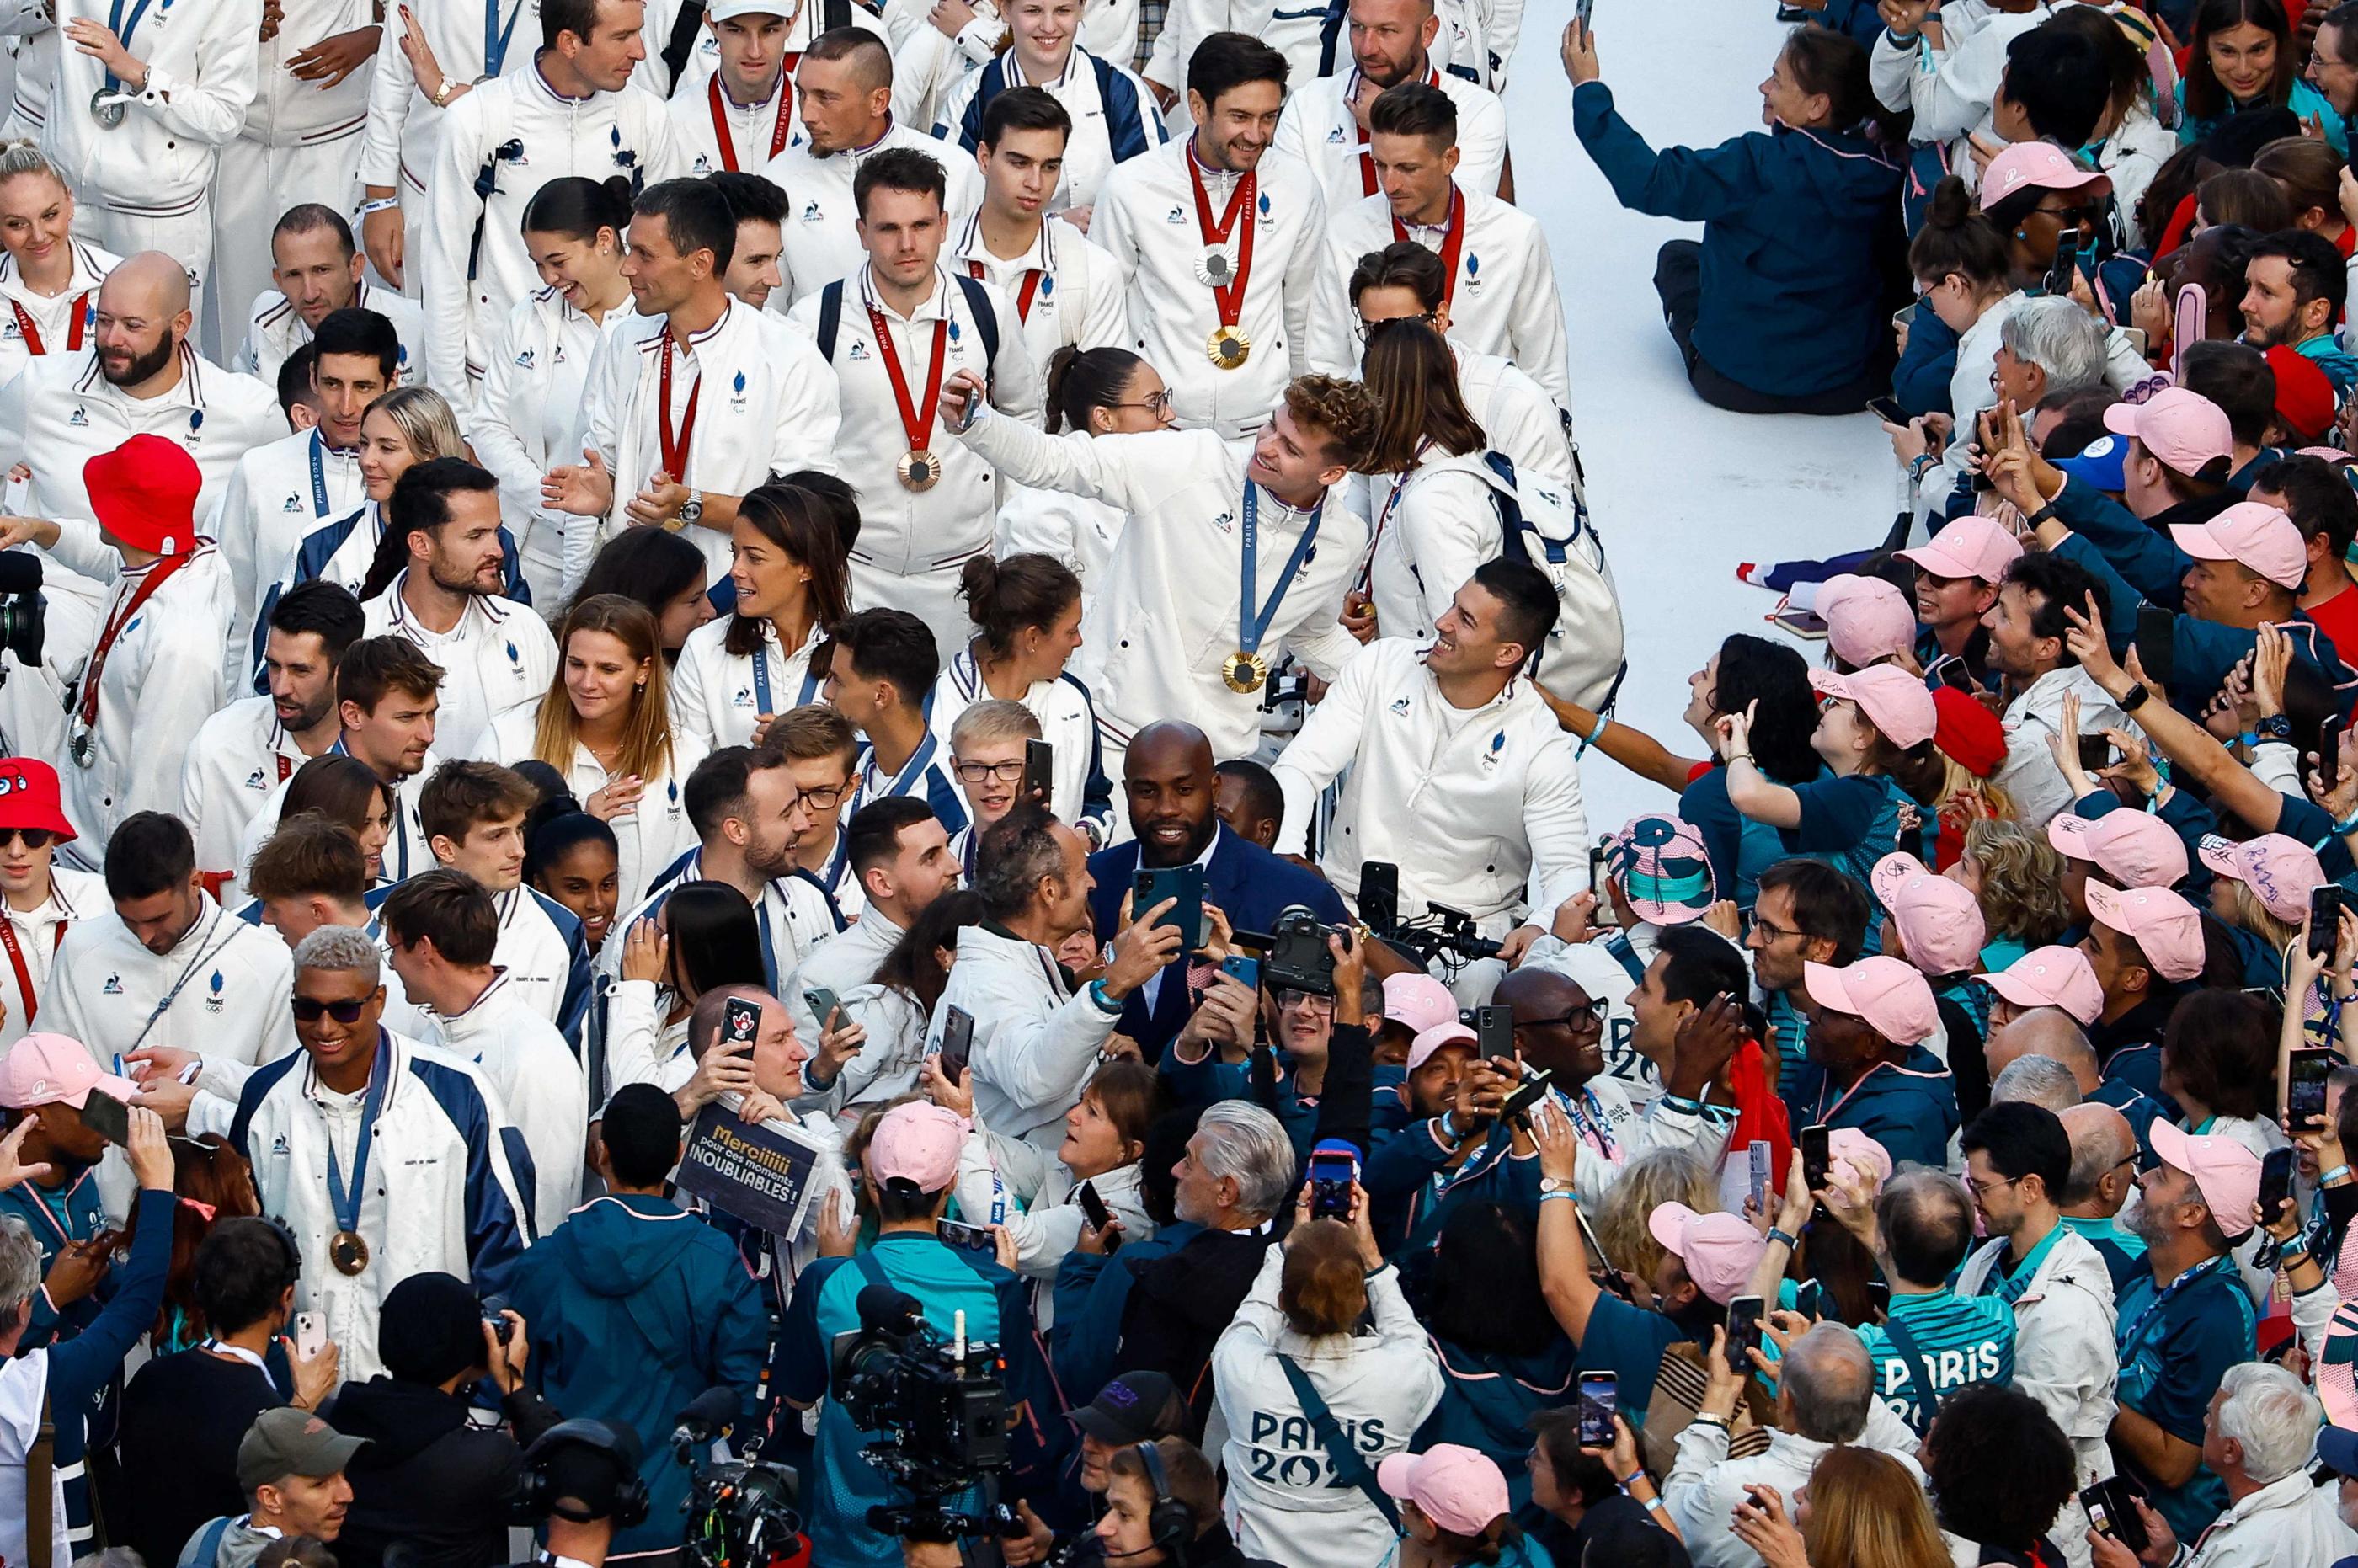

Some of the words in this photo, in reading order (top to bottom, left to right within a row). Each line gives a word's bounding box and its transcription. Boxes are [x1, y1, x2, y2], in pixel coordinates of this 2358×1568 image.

[776, 121, 785, 145] PARIS
[1465, 279, 1480, 287] FRANCE
[877, 326, 888, 349] PARIS
[184, 434, 201, 442] FRANCE
[315, 481, 323, 504] PARIS
[1483, 753, 1498, 765] FRANCE
[3, 929, 15, 952] PARIS
[206, 997, 224, 1005] FRANCE
[712, 1124, 792, 1175] Merciiiiii
[688, 1143, 790, 1203] INOUBLIABLES
[700, 1136, 724, 1153] pour
[725, 1149, 744, 1163] ces
[745, 1159, 794, 1187] moments
